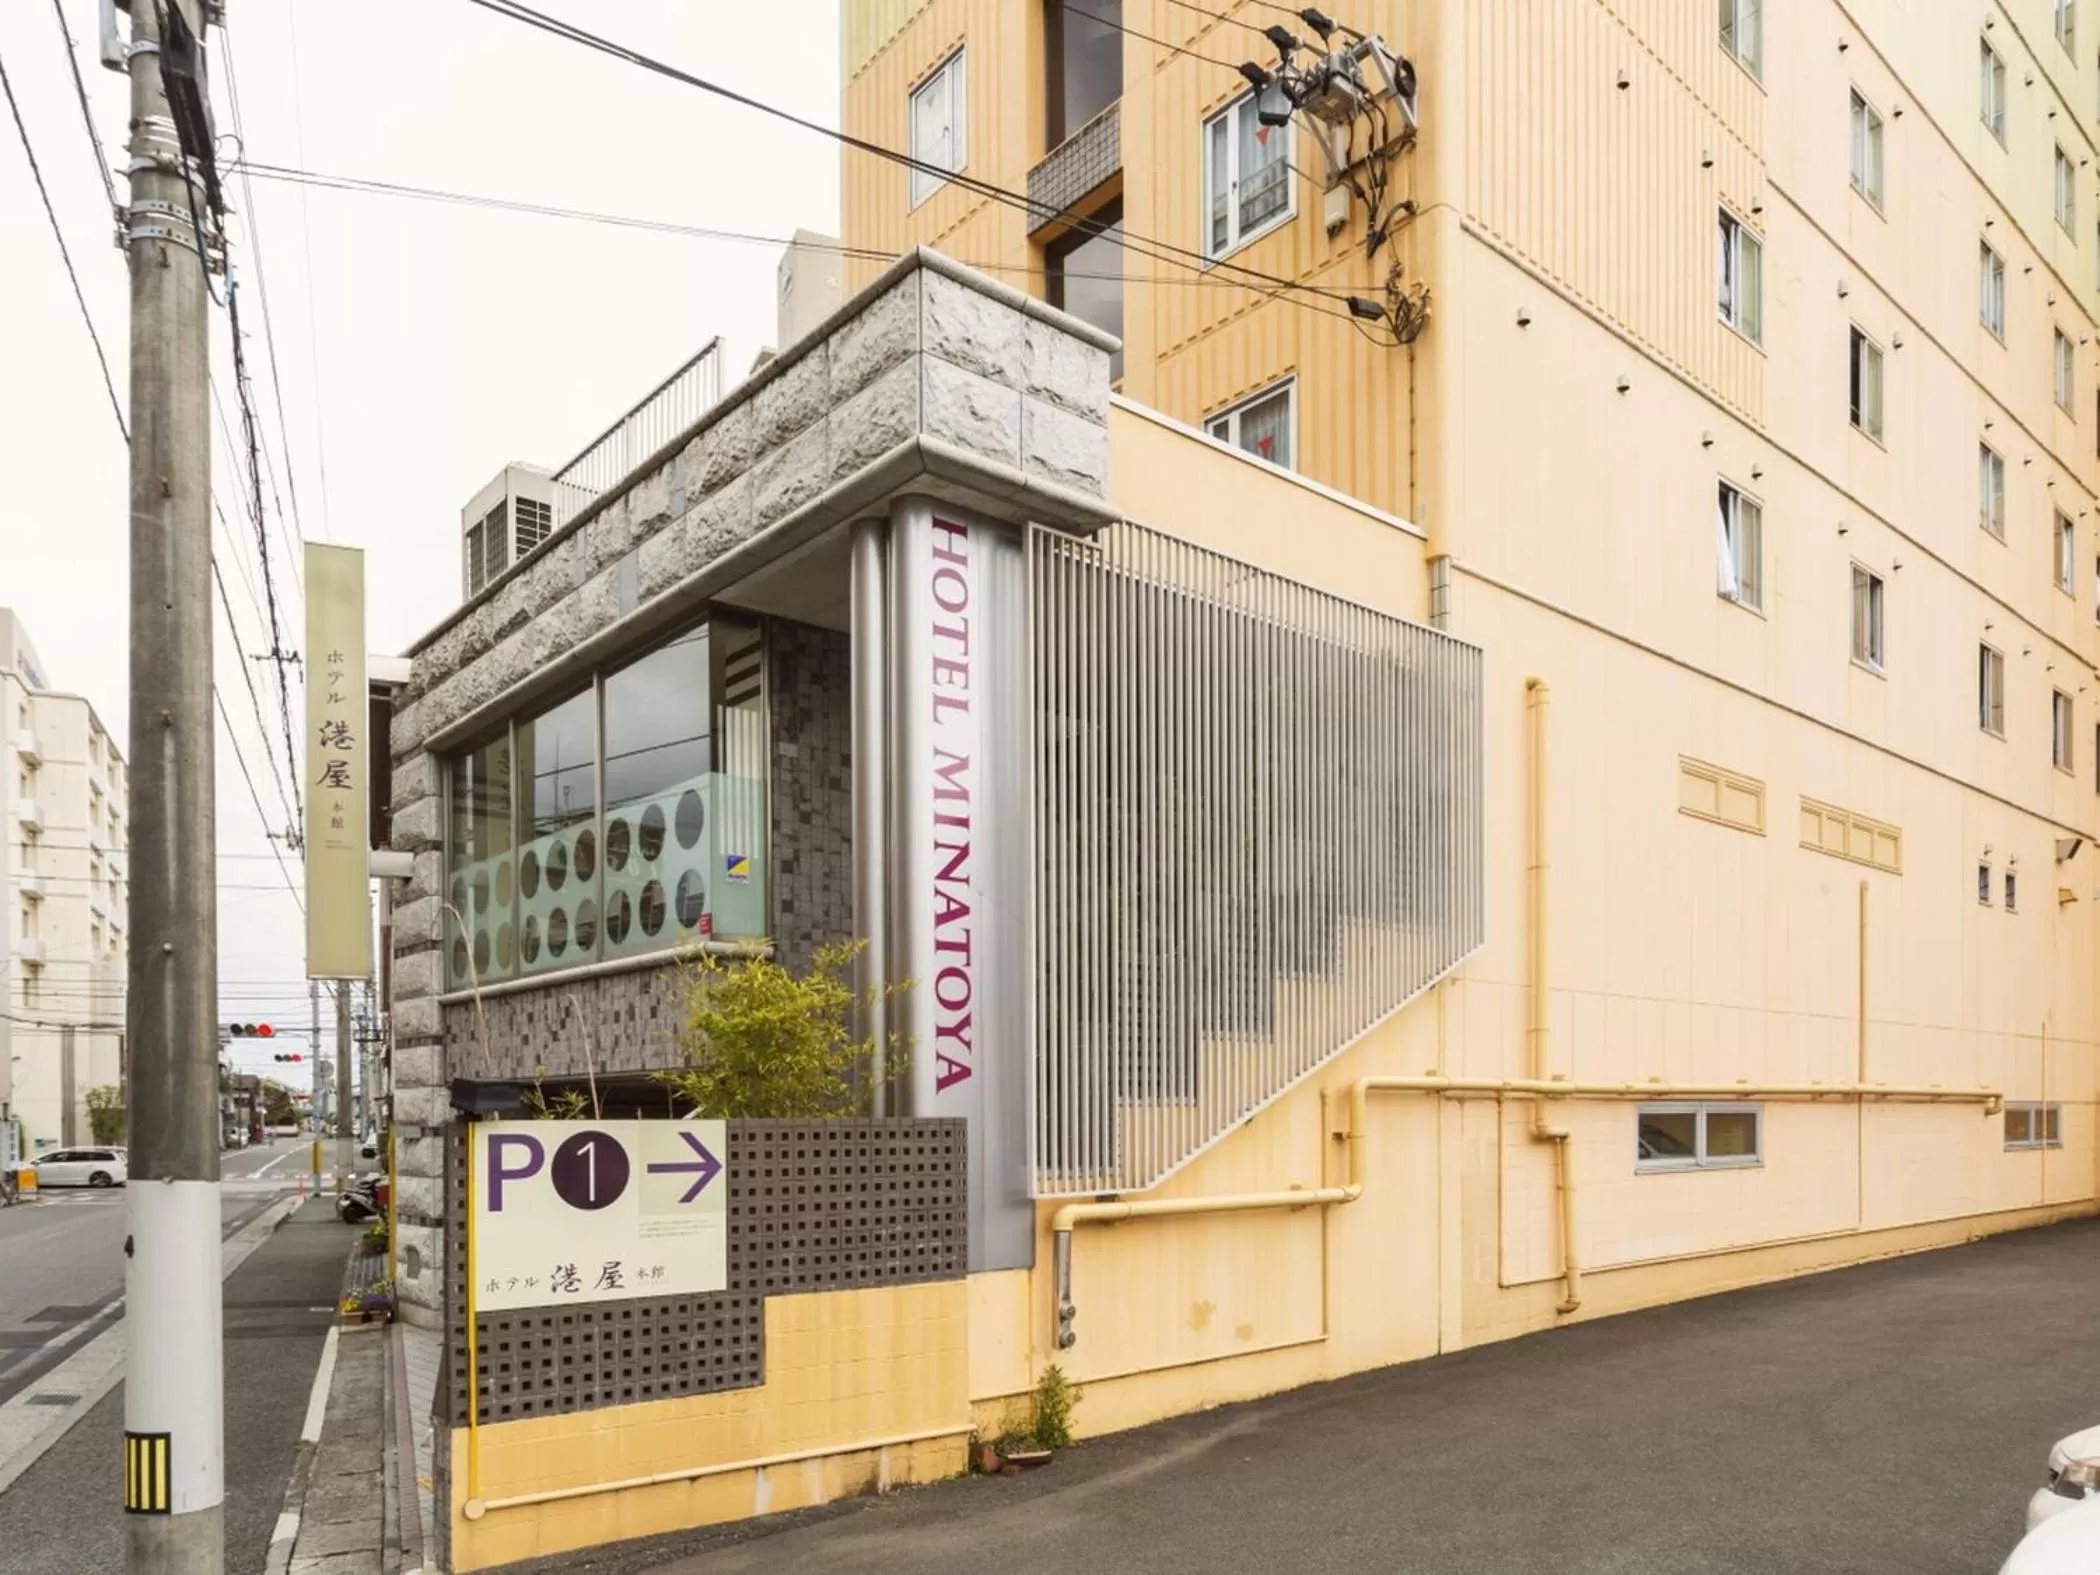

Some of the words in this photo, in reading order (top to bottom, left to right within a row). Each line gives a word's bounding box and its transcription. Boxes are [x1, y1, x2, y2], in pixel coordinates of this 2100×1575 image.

[931, 515, 970, 725] HOTEL
[327, 649, 347, 704] ホテル
[316, 719, 355, 790] 港屋
[933, 746, 973, 1095] MINATOYA
[487, 1133, 545, 1212] P
[485, 1276, 541, 1293] ホテル
[550, 1260, 626, 1294] 港屋
